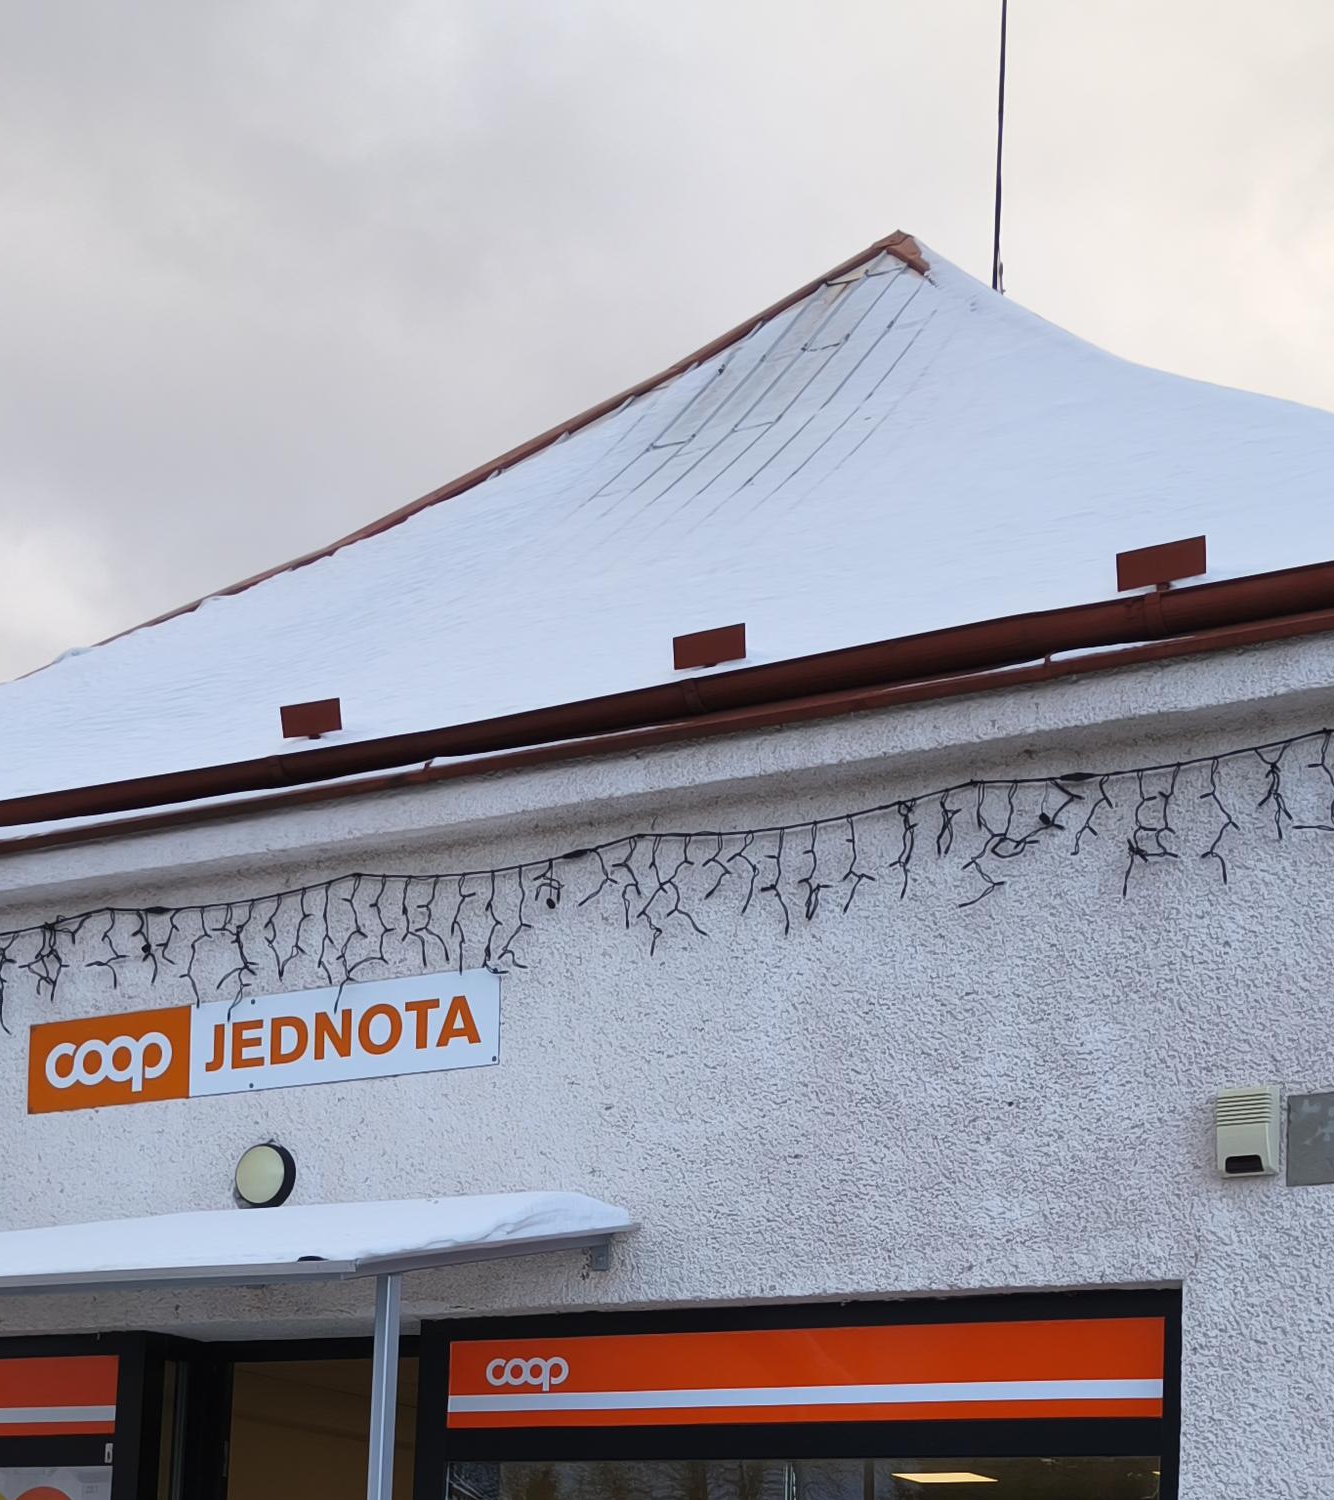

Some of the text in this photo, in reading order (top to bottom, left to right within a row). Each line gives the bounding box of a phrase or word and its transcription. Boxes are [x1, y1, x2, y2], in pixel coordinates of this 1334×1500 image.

[45, 995, 481, 1093] coop JEDNOTA
[486, 1356, 569, 1392] coop
